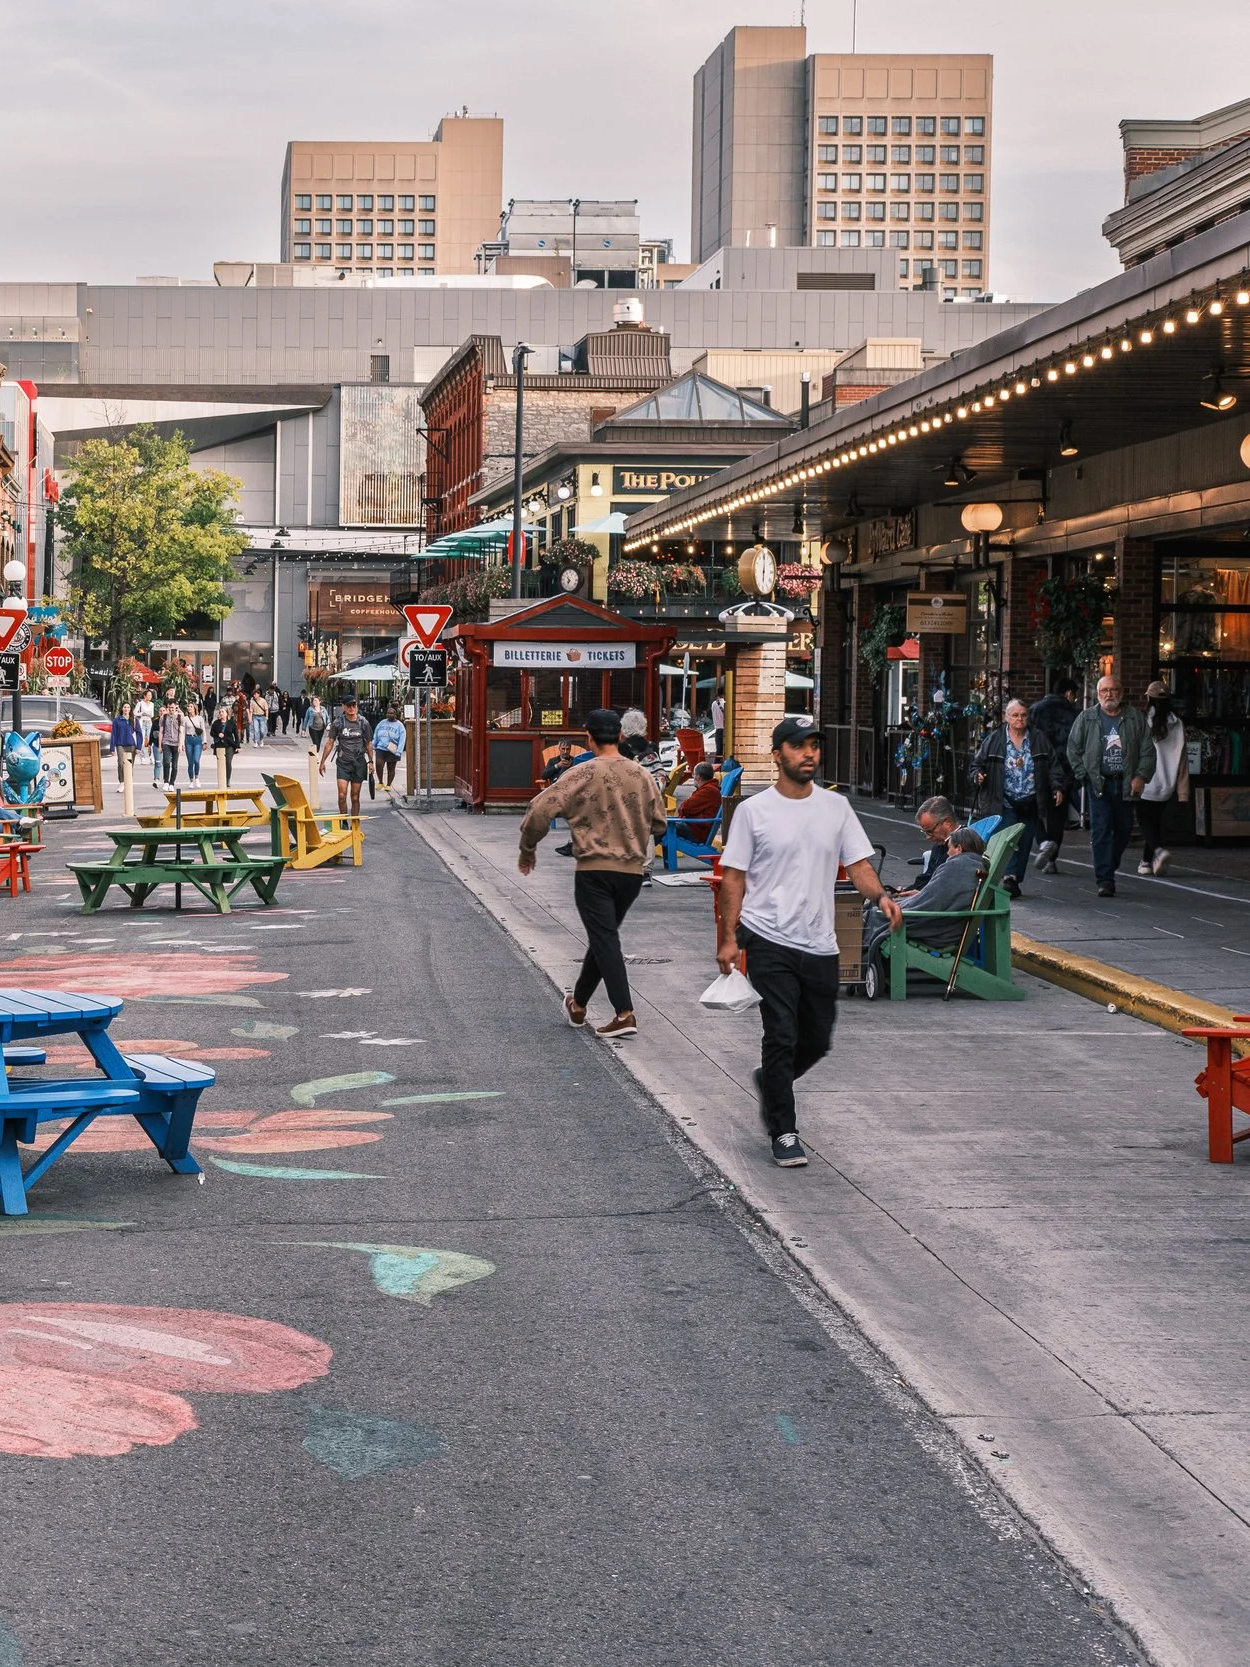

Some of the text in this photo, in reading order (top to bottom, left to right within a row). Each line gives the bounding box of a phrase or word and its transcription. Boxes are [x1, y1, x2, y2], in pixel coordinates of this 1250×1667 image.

[335, 595, 391, 603] BRIDGEH
[414, 654, 442, 662] TO/AUX
[504, 650, 625, 661] BILLETTERIE TICKETS
[46, 656, 72, 668] STOP
